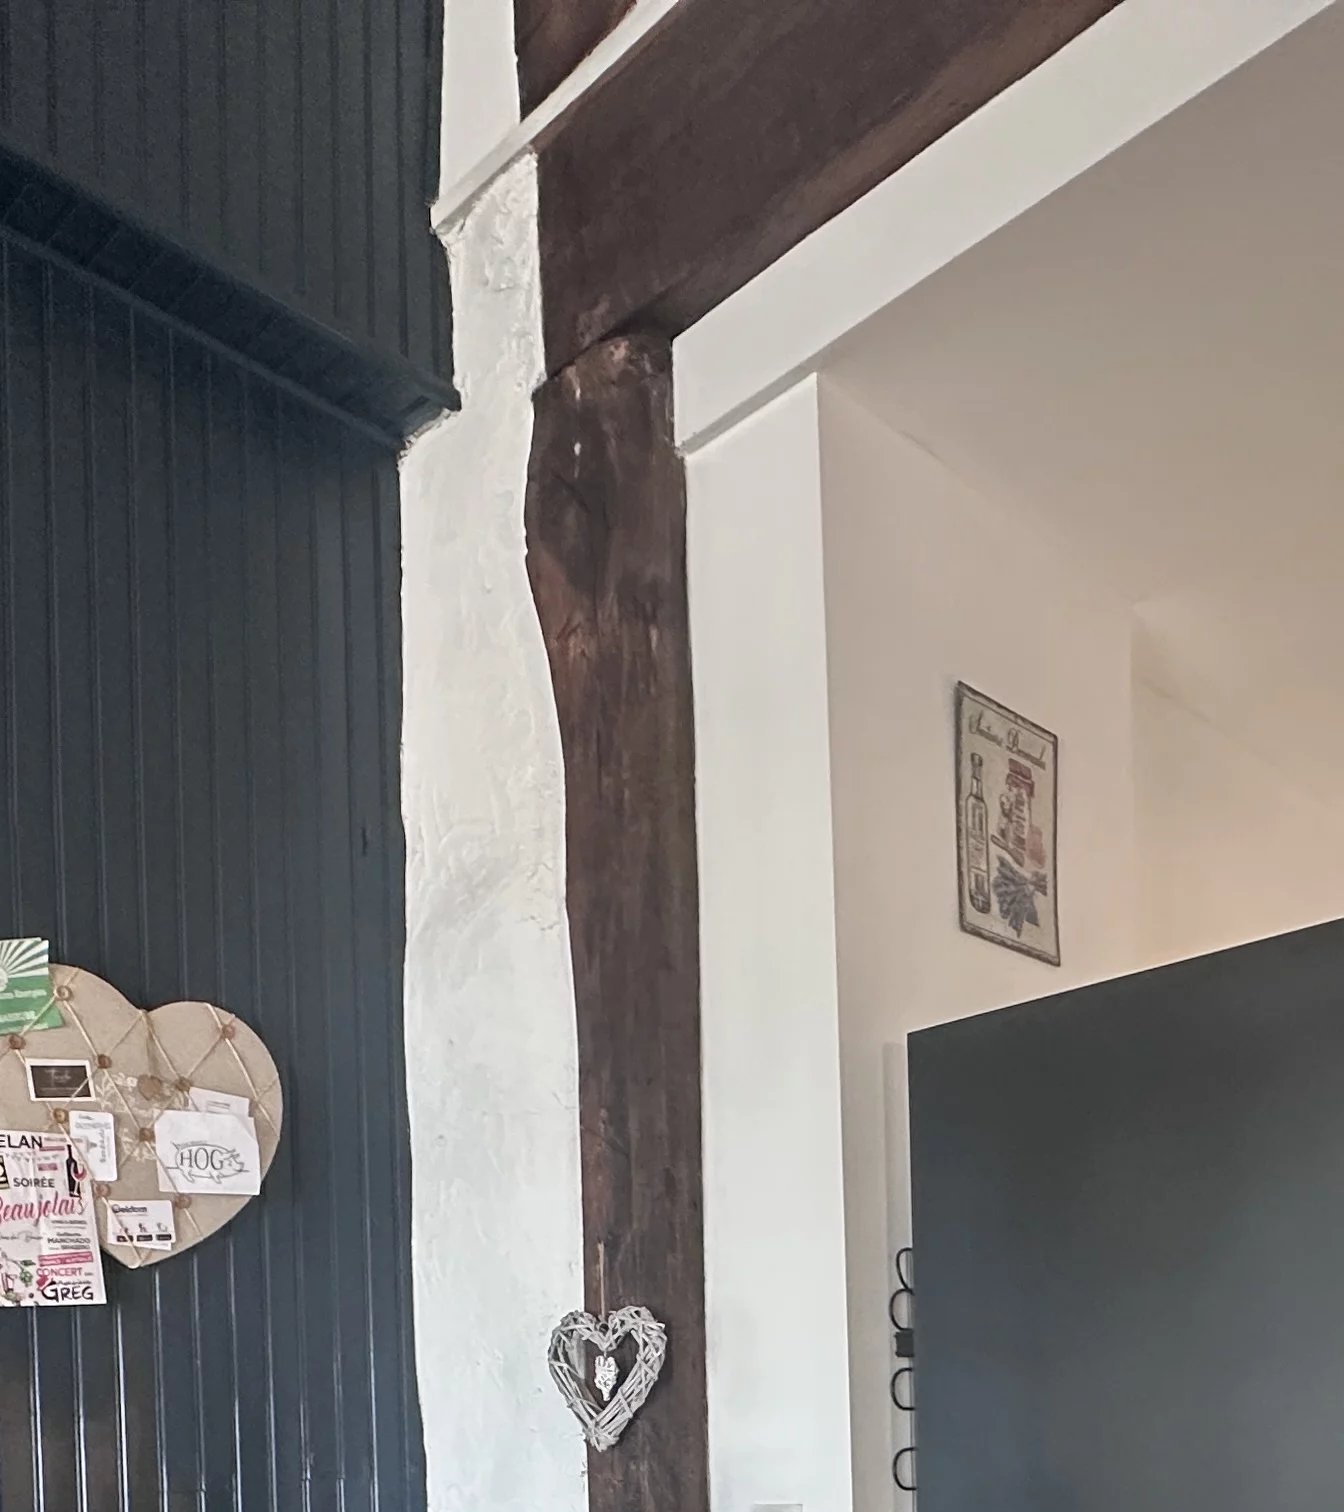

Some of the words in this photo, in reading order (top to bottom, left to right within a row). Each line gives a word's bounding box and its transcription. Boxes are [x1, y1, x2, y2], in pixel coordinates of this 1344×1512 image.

[179, 1147, 224, 1170] HOG
[12, 1176, 56, 1188] SOIRÉE
[36, 1267, 83, 1277] CONCERT
[40, 1281, 94, 1302] GREG
